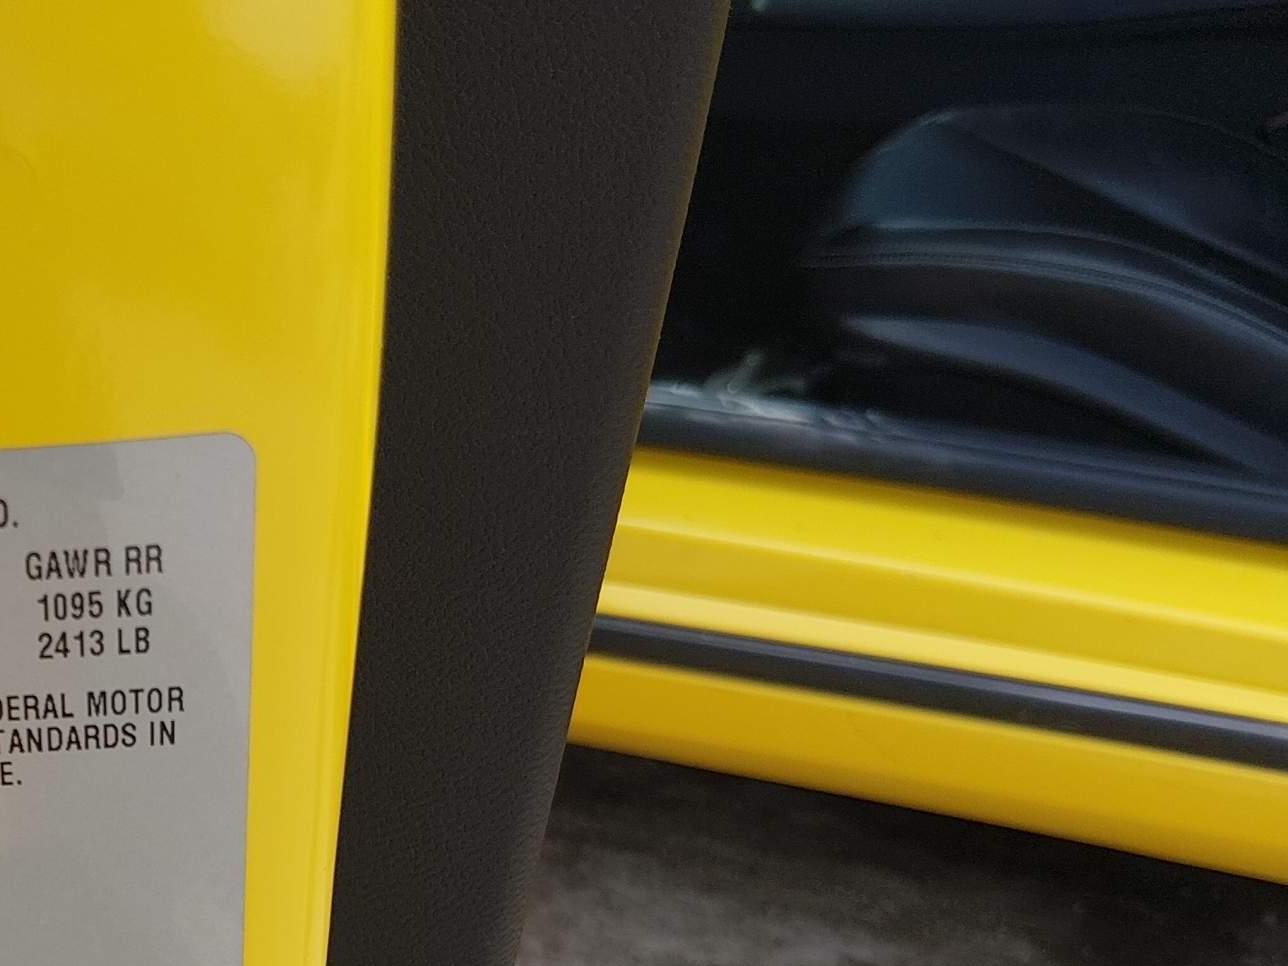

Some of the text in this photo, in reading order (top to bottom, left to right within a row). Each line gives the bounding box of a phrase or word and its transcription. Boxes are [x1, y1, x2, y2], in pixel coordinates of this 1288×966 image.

[25, 544, 163, 581] GAWR RR
[38, 588, 152, 622] 1095 KG
[38, 626, 150, 659] 2413 LB
[87, 686, 184, 717] MOTOR
[150, 720, 175, 746] IN
